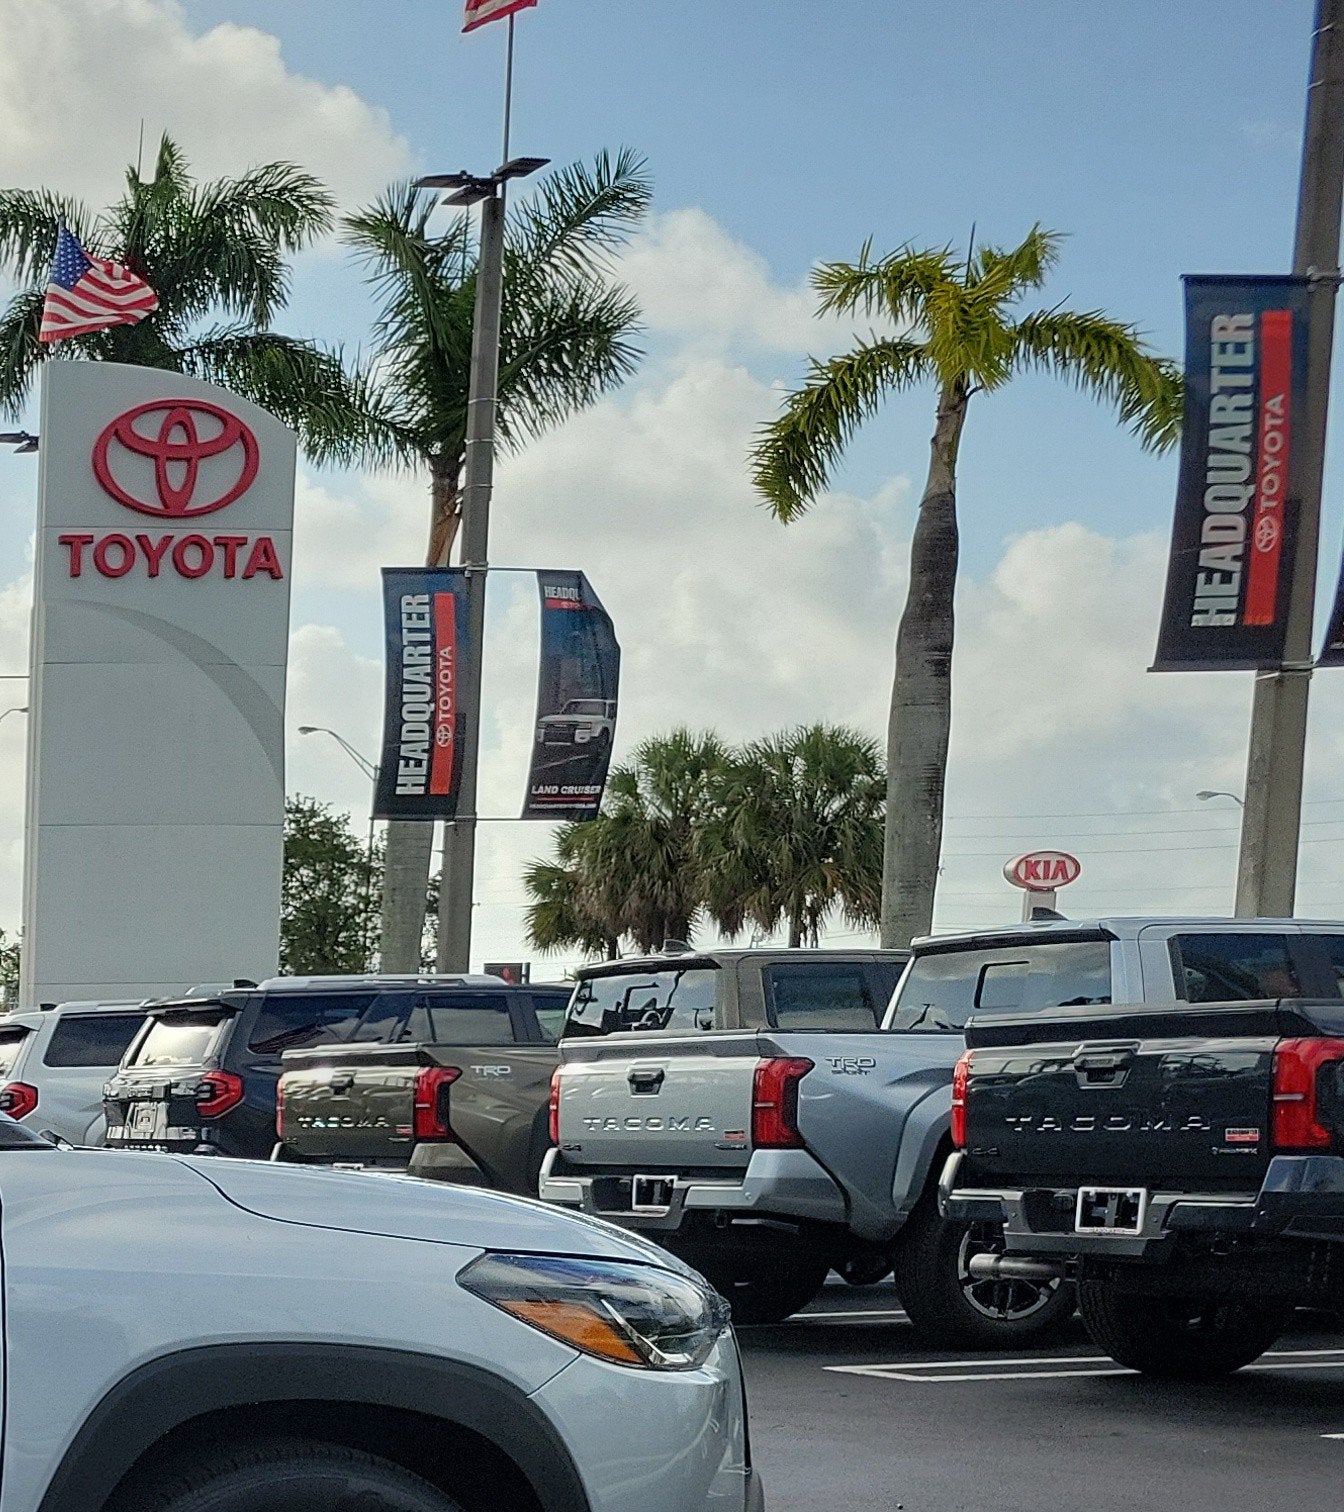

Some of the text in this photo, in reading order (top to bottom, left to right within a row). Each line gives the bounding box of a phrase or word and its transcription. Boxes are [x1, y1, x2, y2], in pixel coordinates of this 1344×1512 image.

[1259, 393, 1284, 513] TOYOTA
[1191, 313, 1256, 627] HEADQUARTER
[58, 534, 283, 580] TOYOTA
[439, 645, 452, 723] TOYOTA
[395, 594, 436, 795] HEADQUARTER
[531, 785, 602, 794] LAND CRUISER
[1023, 859, 1069, 880] KIA
[470, 1065, 511, 1076] TRD
[825, 1057, 876, 1071] TRD
[297, 1116, 390, 1129] TACOMA
[583, 1116, 715, 1131] TACOMA
[1005, 1115, 1211, 1131] TACOMA
